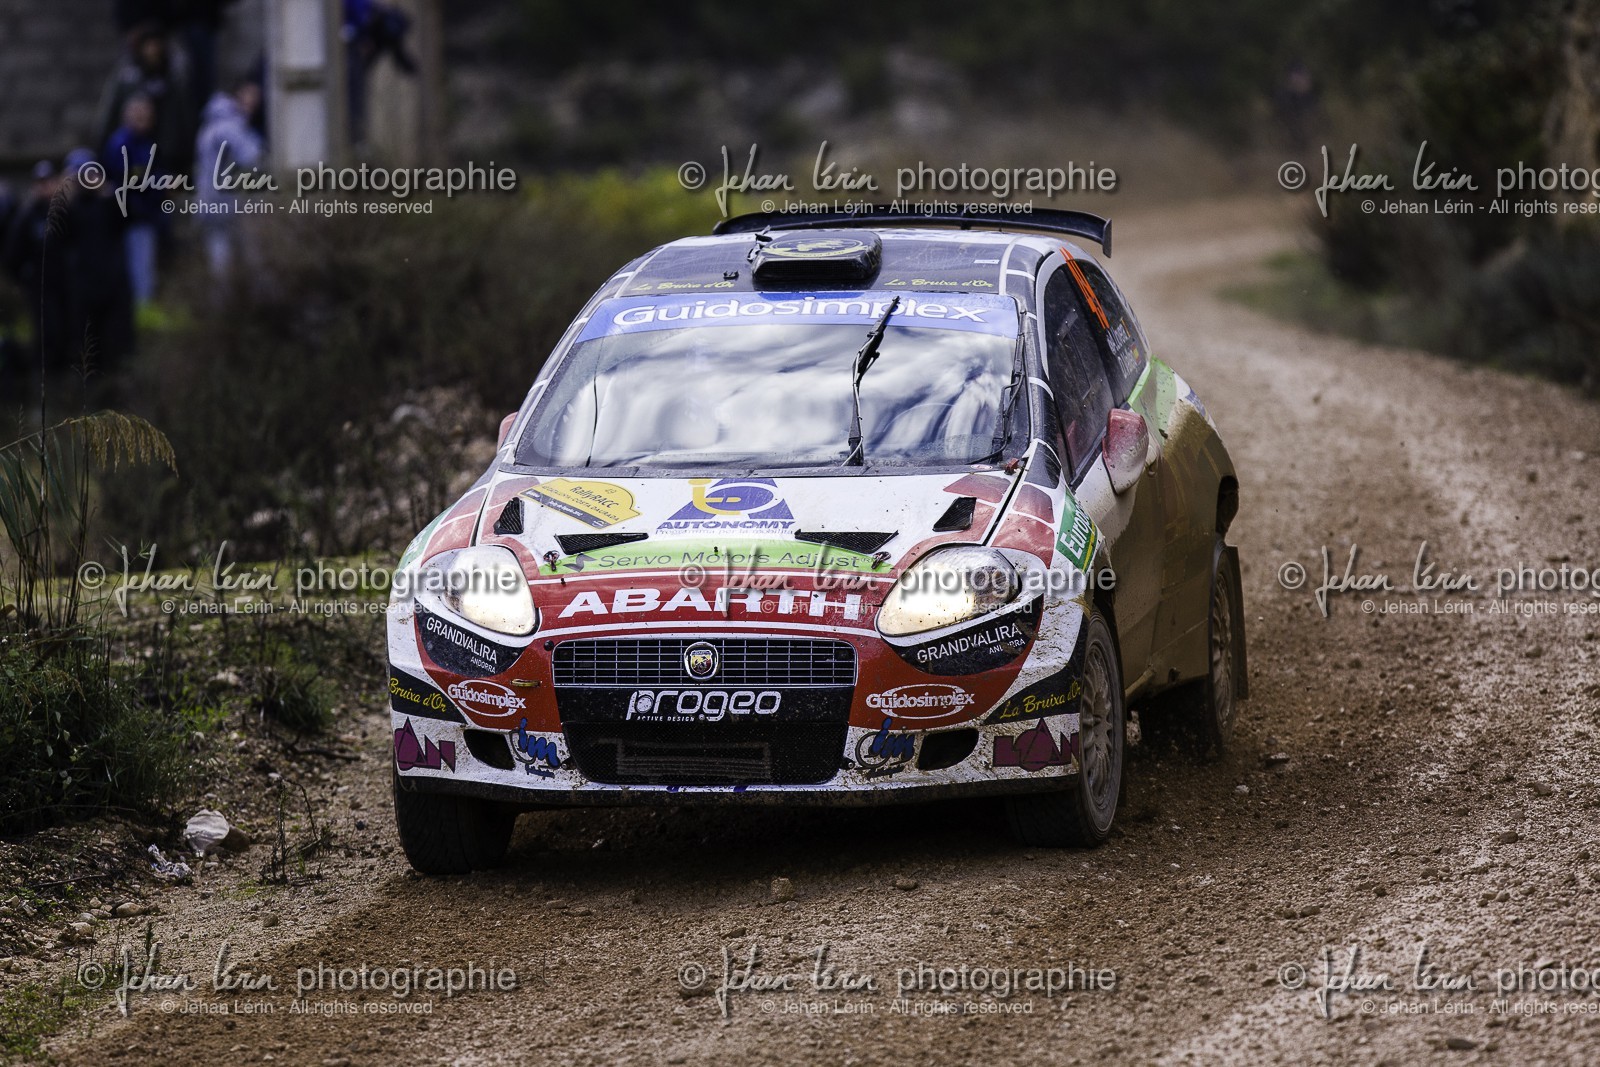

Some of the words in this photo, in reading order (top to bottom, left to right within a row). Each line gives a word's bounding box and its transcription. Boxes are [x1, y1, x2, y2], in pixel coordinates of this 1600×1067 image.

[884, 279, 906, 287] La
[912, 279, 958, 287] Bruixa
[613, 296, 988, 326] Guidosimplex
[656, 520, 796, 530] AUTONOMY
[599, 554, 672, 567] Servo
[681, 551, 770, 566] Motors
[557, 587, 862, 621] ABARTH
[426, 616, 498, 665] GRANDVALIRA
[917, 622, 1022, 664] GRANDVALIRA
[989, 638, 1026, 655] ANRRA
[470, 656, 496, 675] ANDORRA
[390, 677, 421, 703] Bruixa
[422, 693, 447, 712] d'Or
[448, 683, 527, 709] Guidosimplex
[625, 690, 782, 722] progeo
[866, 690, 976, 708] Guidosimplex
[1000, 701, 1020, 720] La
[1023, 693, 1066, 713] Bruixa
